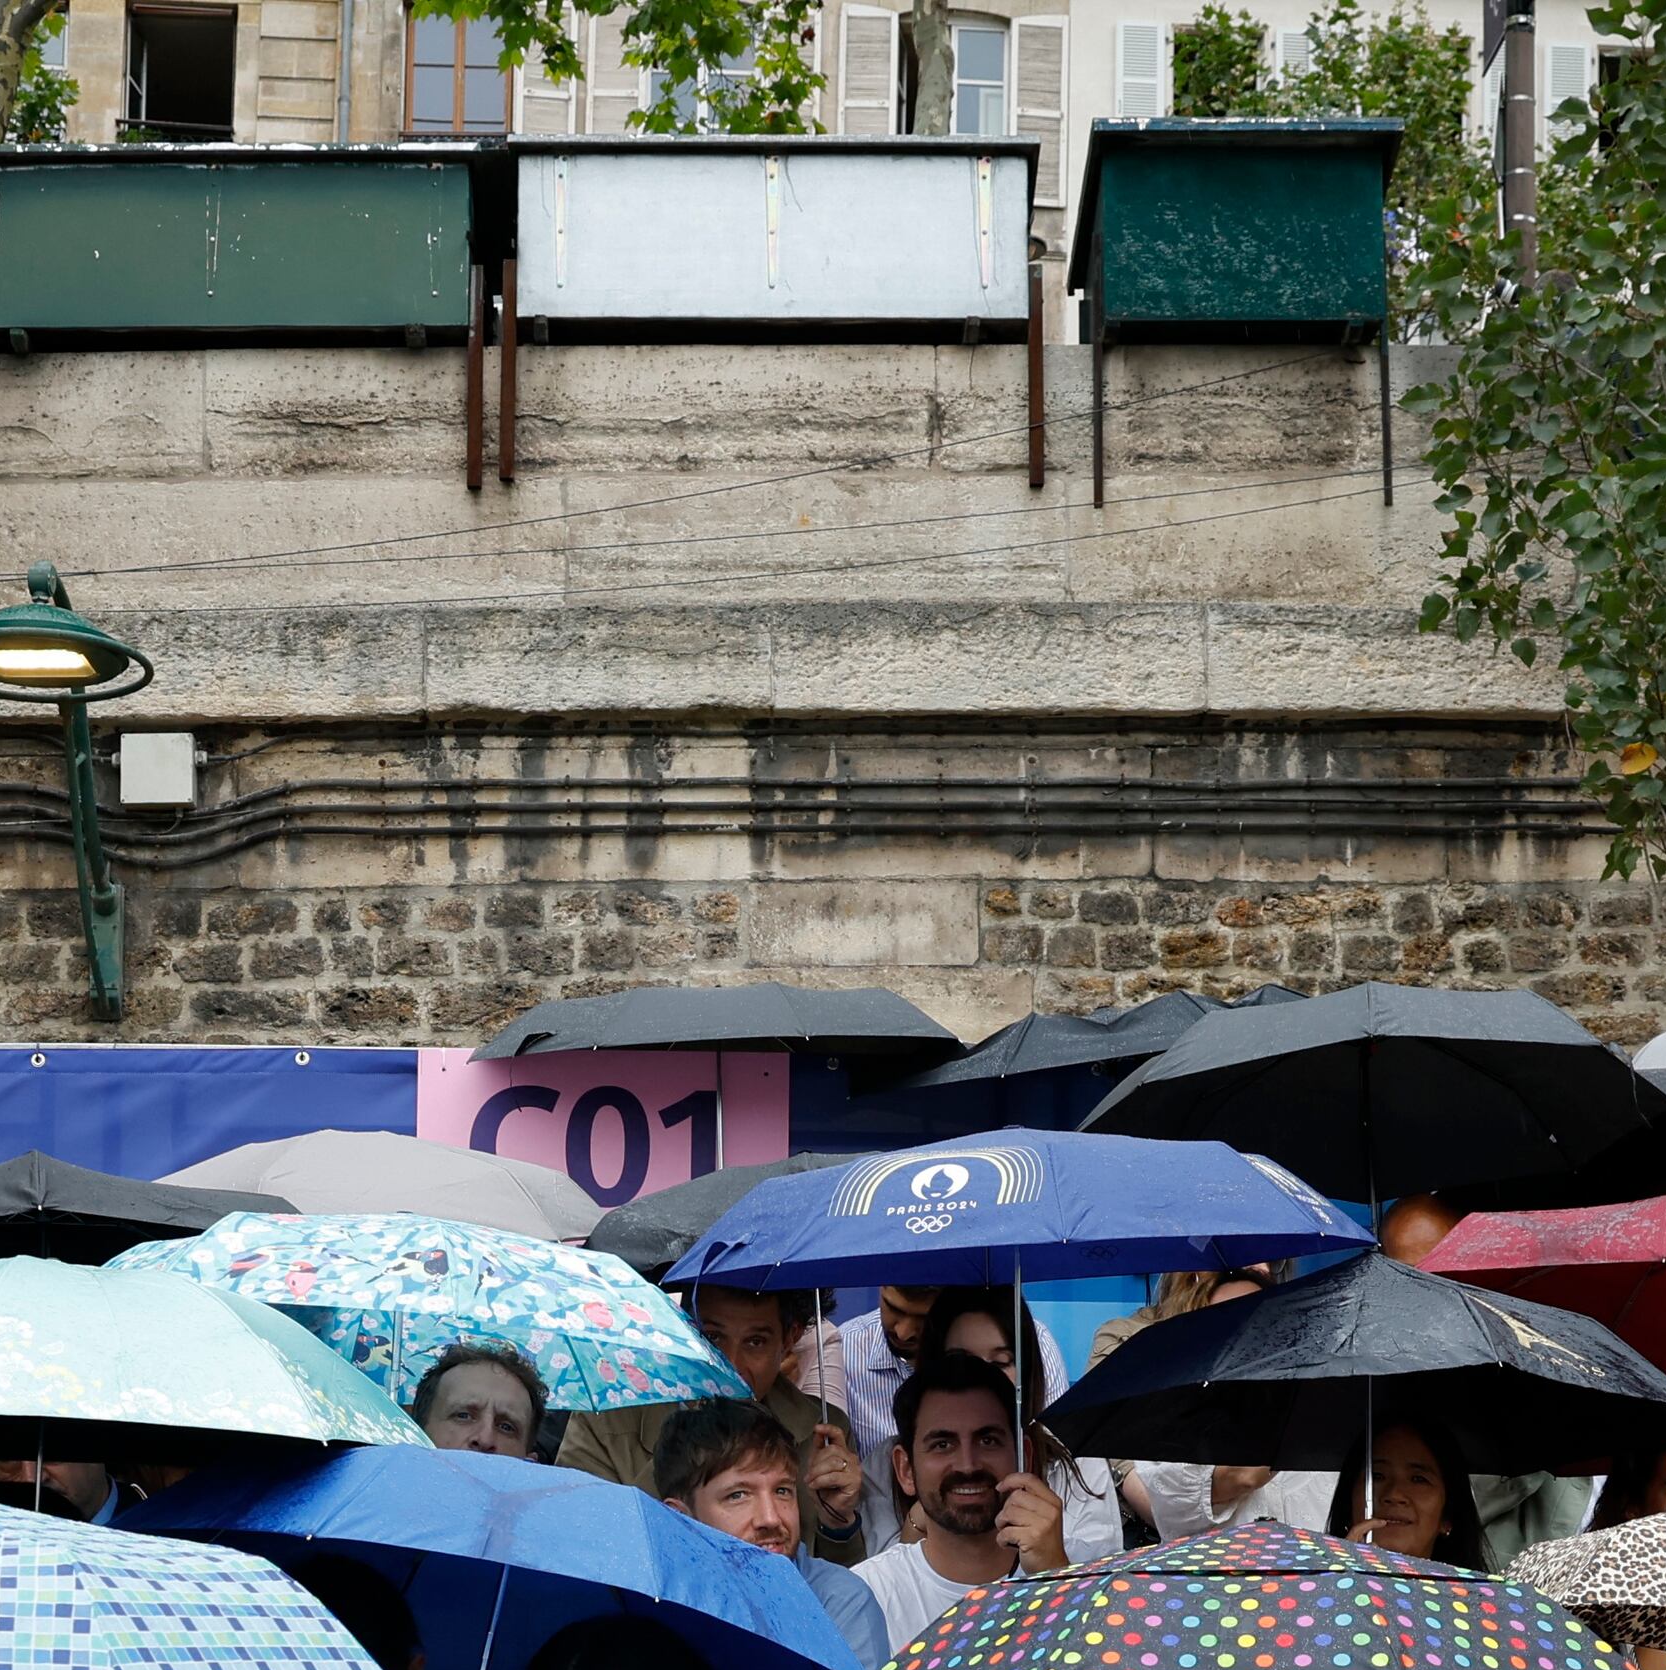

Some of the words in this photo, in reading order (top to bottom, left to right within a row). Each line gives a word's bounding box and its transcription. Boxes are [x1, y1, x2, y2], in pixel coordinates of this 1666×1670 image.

[469, 1085, 718, 1208] C01
[886, 1204, 932, 1216] PARIS
[936, 1200, 977, 1212] 2024
